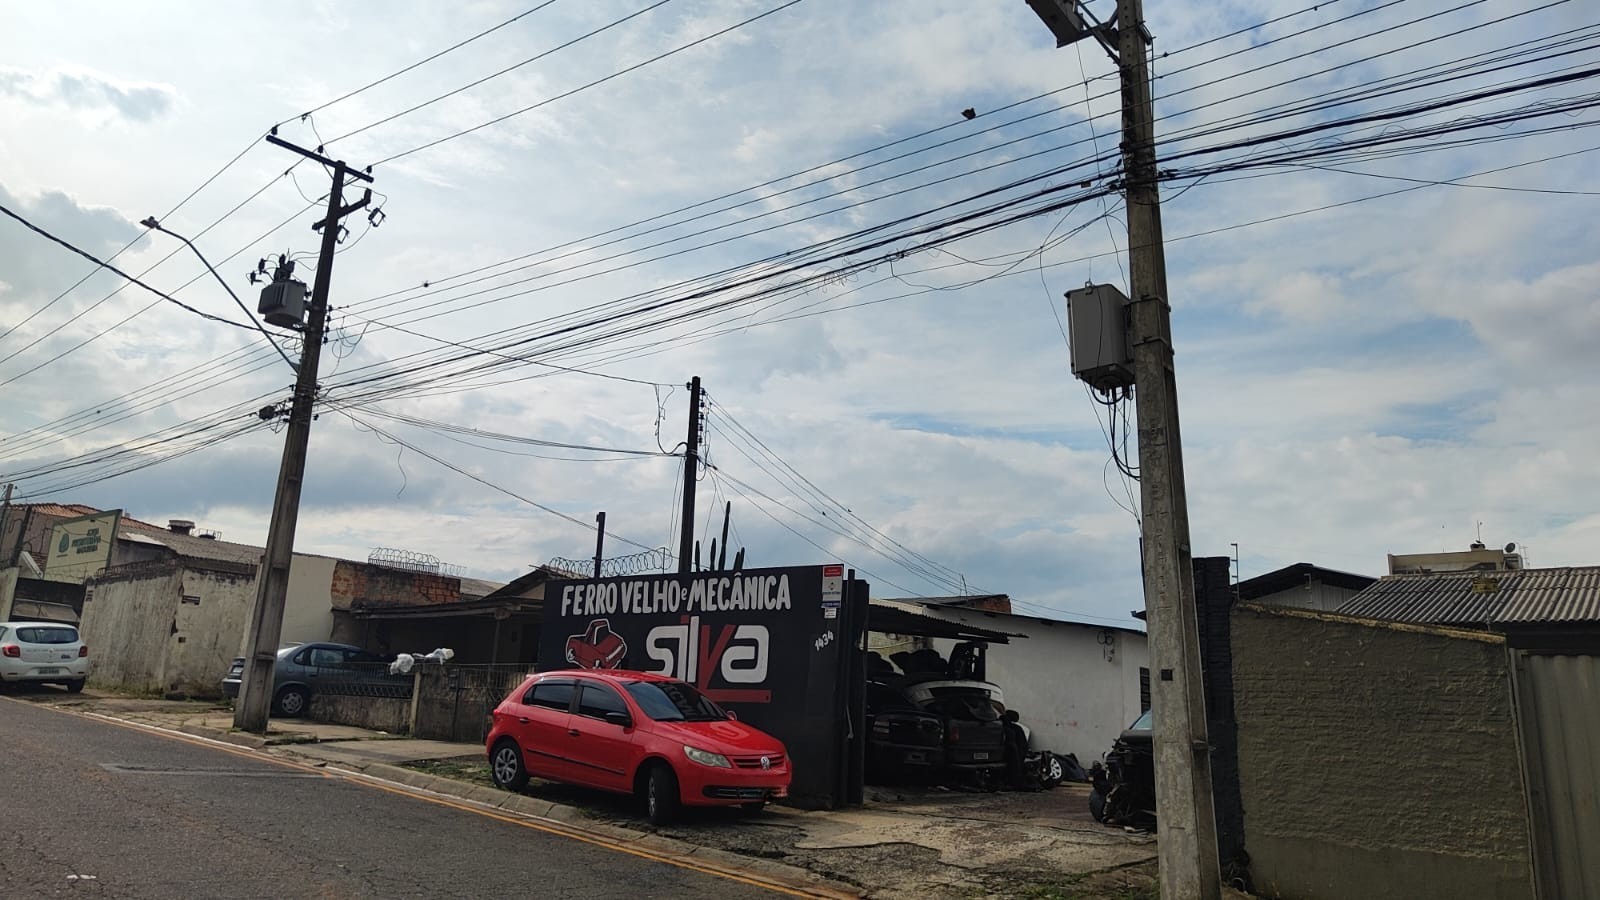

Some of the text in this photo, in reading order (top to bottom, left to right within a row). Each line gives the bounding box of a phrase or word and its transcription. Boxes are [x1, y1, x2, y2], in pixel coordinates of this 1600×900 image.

[561, 583, 617, 616] FERRO
[620, 579, 680, 613] VELHO
[687, 572, 791, 612] MECÂNICA
[815, 630, 834, 651] 1434
